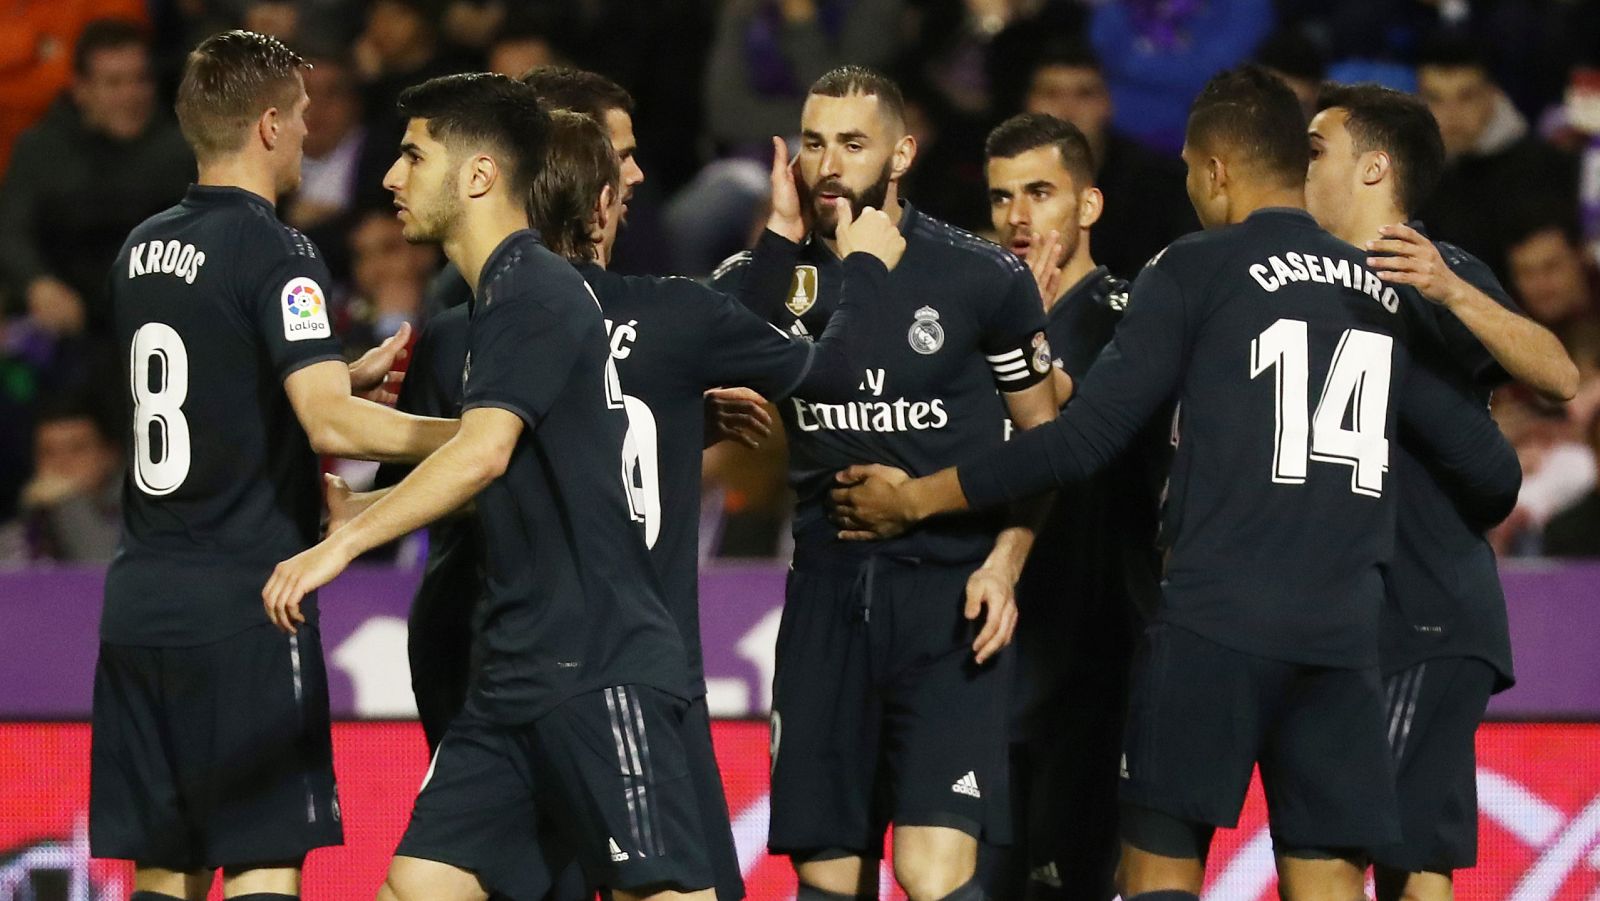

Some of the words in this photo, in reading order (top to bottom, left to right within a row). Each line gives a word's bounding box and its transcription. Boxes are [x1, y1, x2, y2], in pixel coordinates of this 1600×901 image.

[128, 239, 206, 285] KROOS
[1249, 251, 1400, 314] CASEMIRO
[289, 319, 326, 331] LaLiga
[130, 322, 191, 496] 8
[790, 396, 949, 432] Emirates
[1250, 318, 1394, 499] 14
[951, 783, 981, 798] adidas
